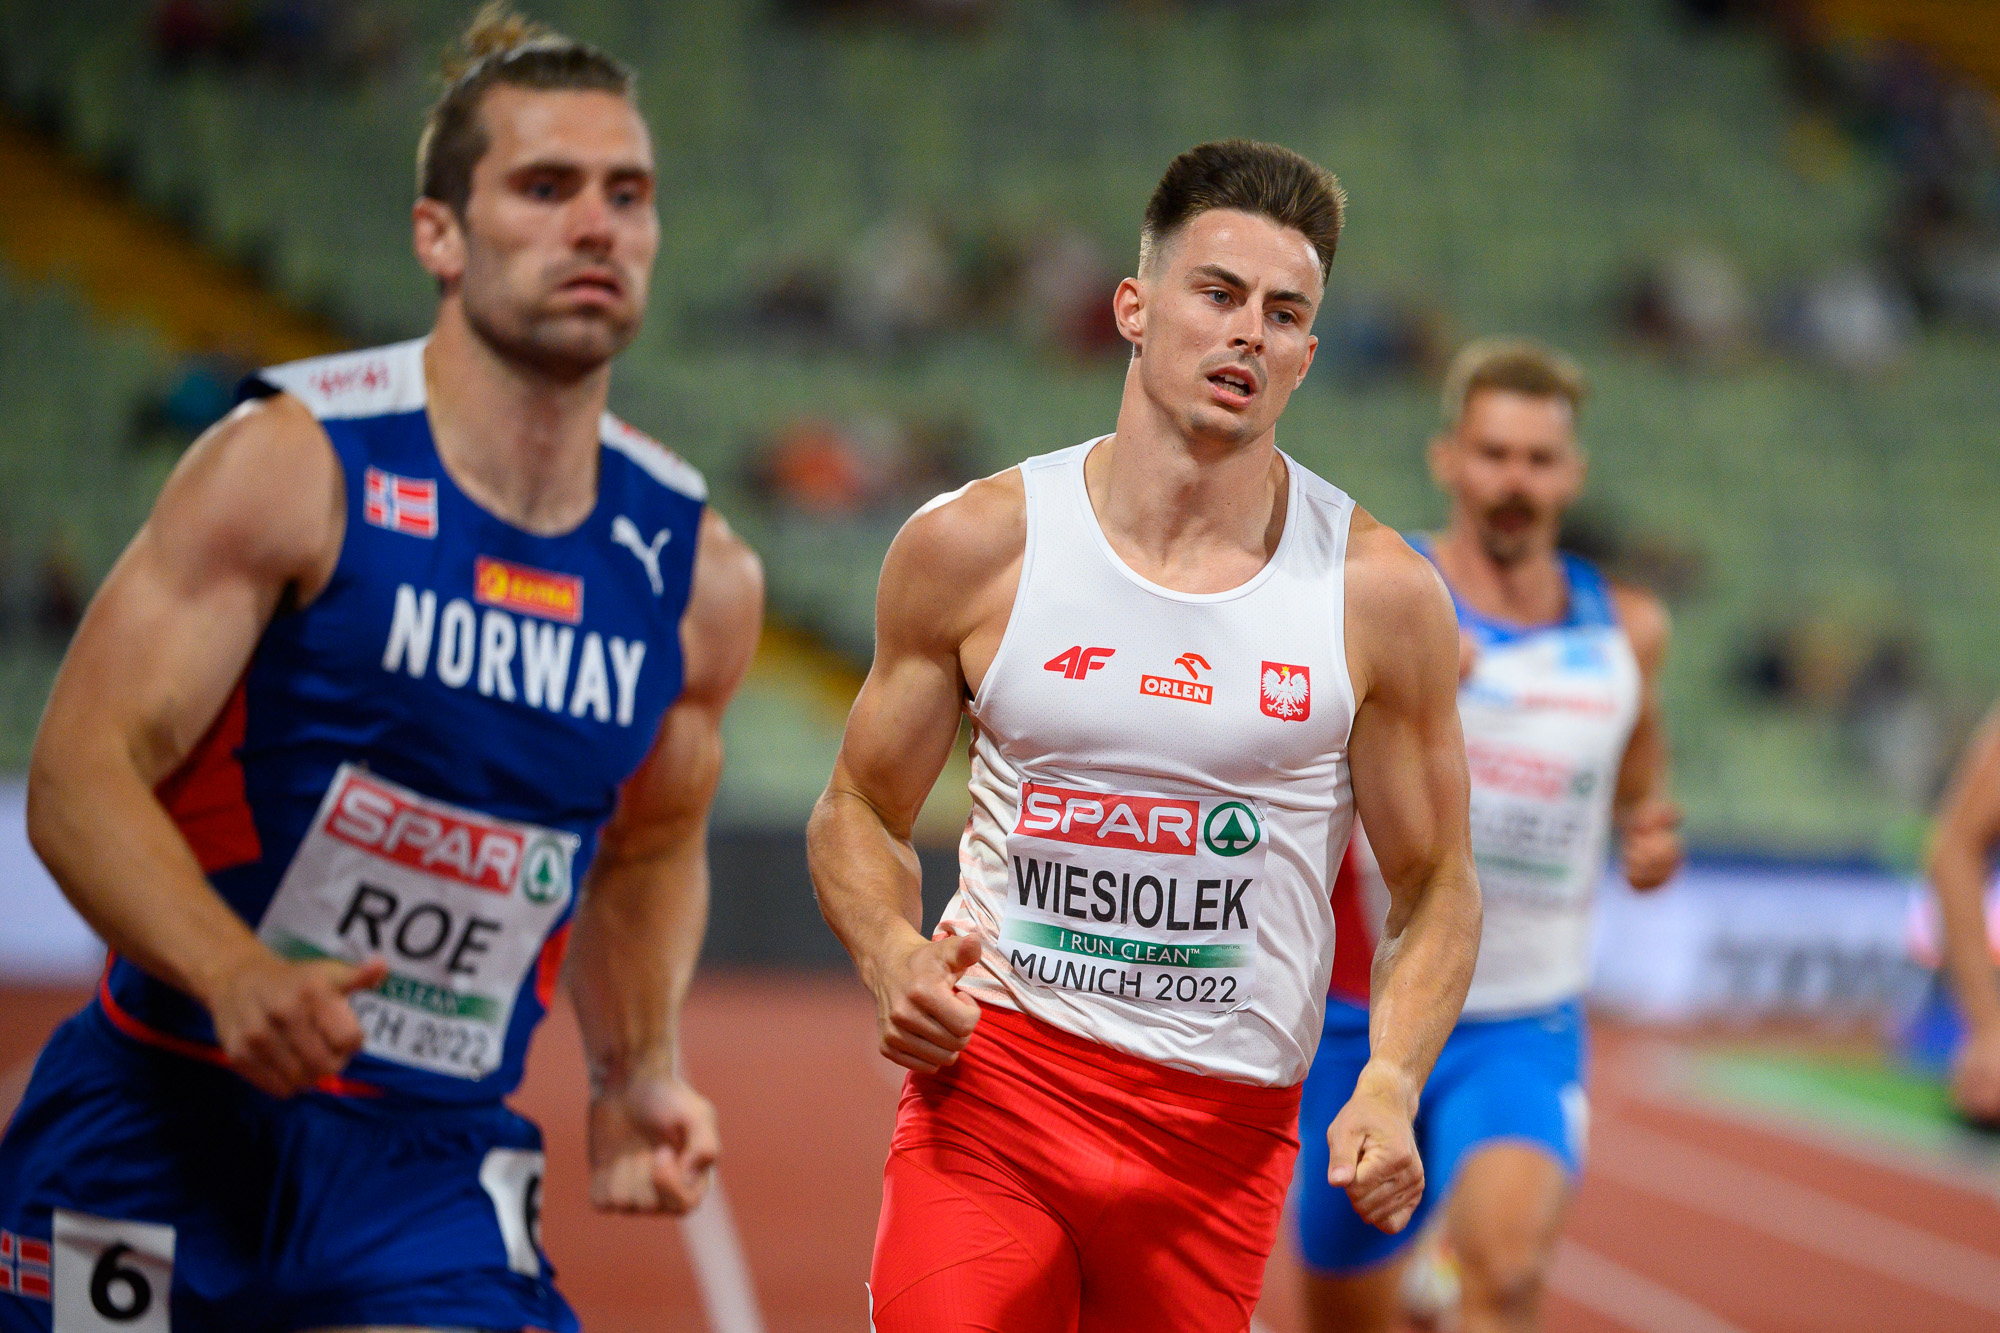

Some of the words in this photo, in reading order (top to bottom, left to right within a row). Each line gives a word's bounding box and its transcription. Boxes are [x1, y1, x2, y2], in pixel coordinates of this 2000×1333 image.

[381, 583, 647, 728] NORWAY
[1043, 645, 1116, 680] 4F
[1144, 678, 1209, 702] ORLEN
[331, 786, 518, 885] SPAR
[1023, 792, 1192, 847] SPAR
[1012, 855, 1253, 931] WIESIOLEK
[336, 880, 502, 975] ROE
[1059, 931, 1065, 948] I
[1071, 933, 1114, 957] RUN
[1011, 949, 1142, 998] MUNICH
[1155, 973, 1237, 1003] 2022
[91, 1240, 152, 1321] 6
